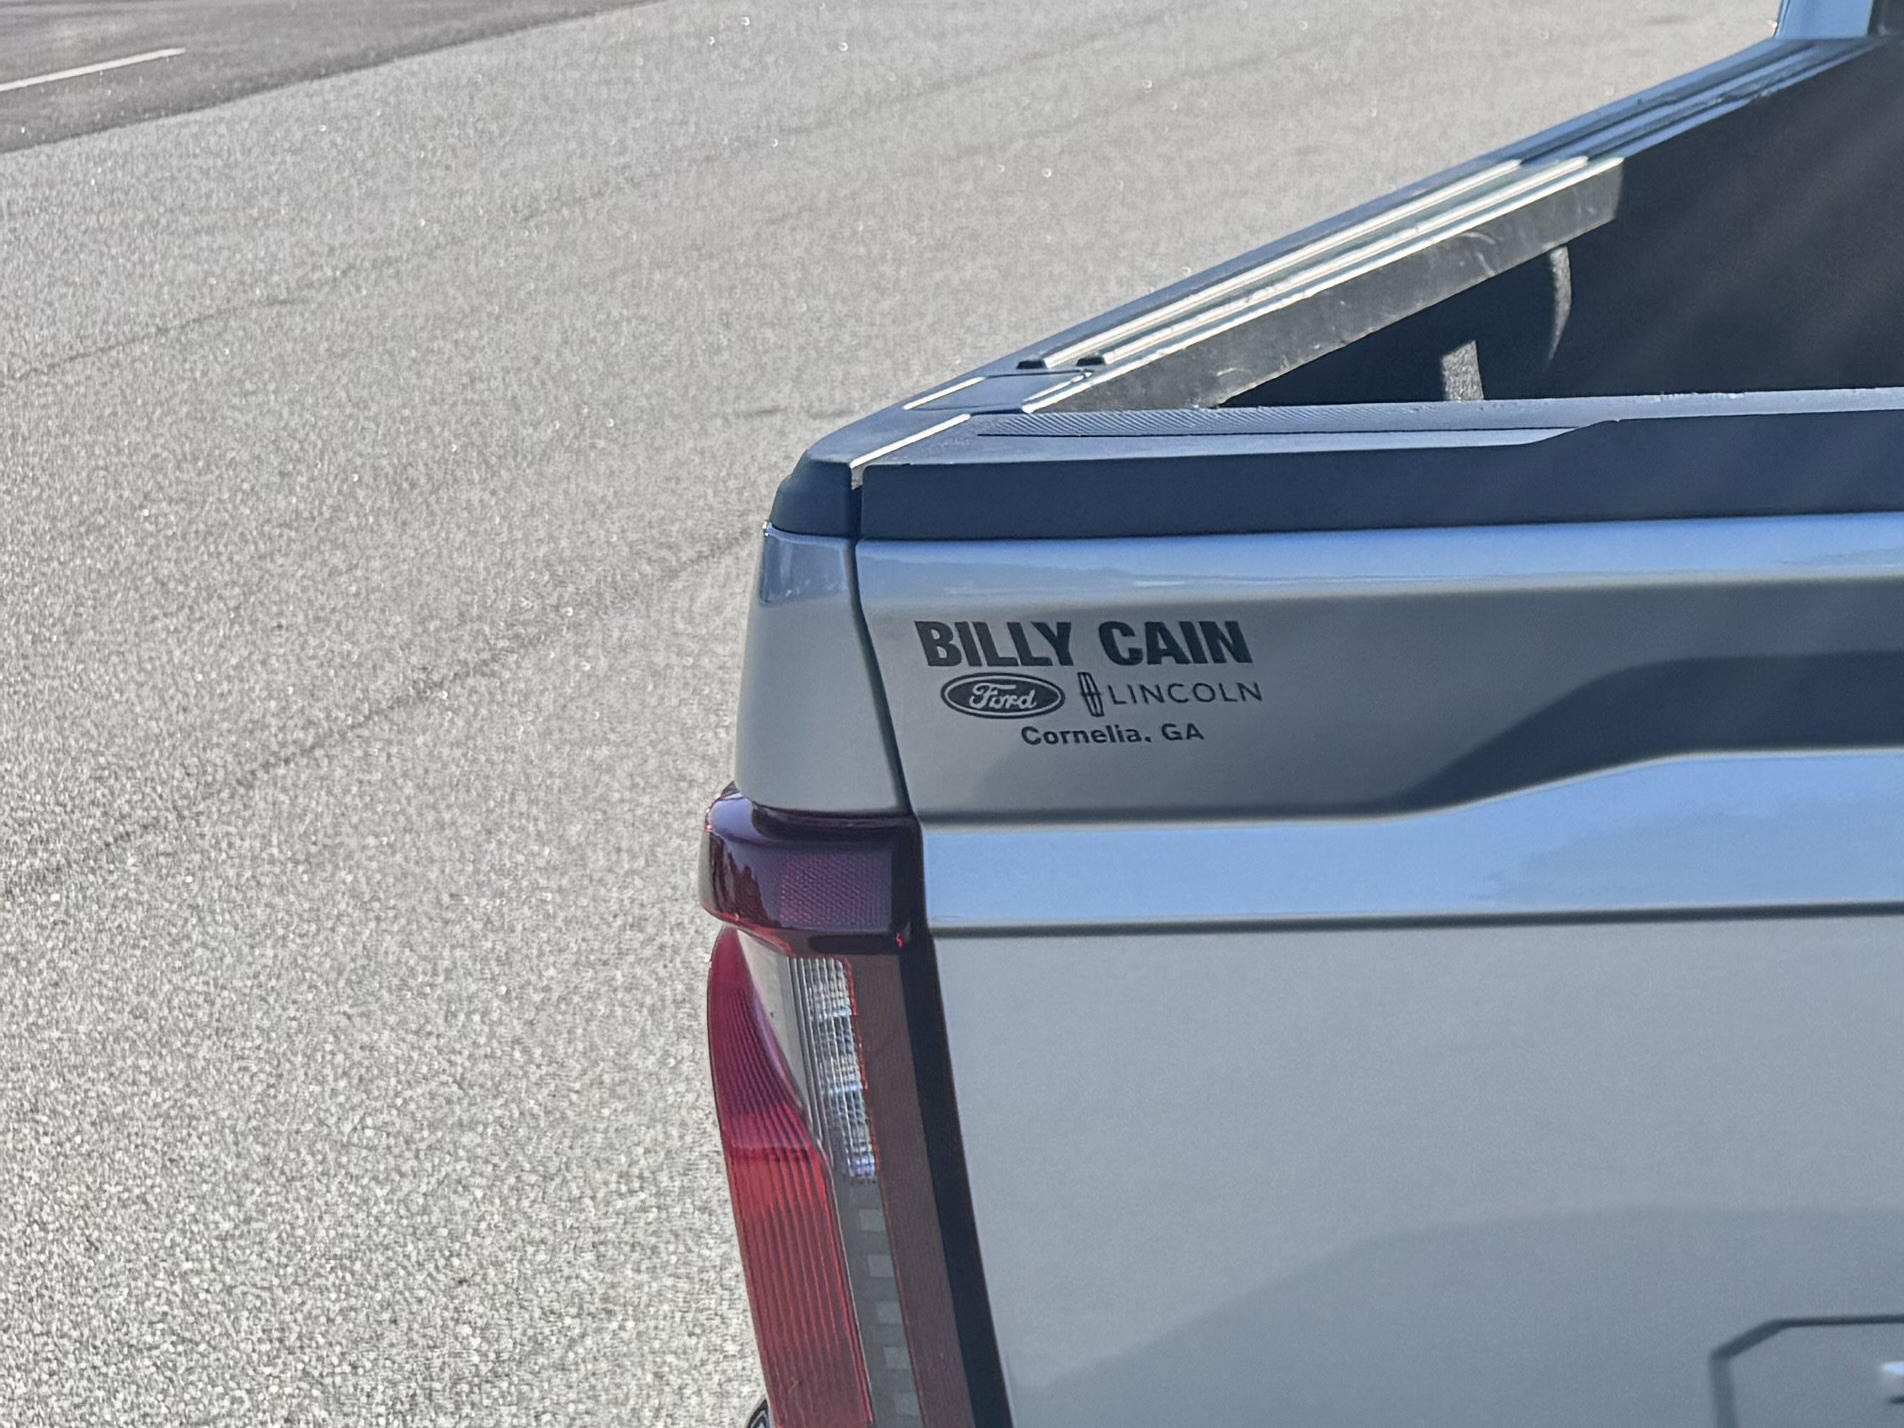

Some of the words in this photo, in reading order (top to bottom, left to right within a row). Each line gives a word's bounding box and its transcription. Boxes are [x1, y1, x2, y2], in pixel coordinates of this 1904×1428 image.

[914, 620, 1075, 668] BILLY
[1098, 620, 1252, 665] CAIN
[968, 682, 1038, 711] Ford
[1109, 681, 1263, 706] LINCOLN
[1160, 722, 1205, 741] GA
